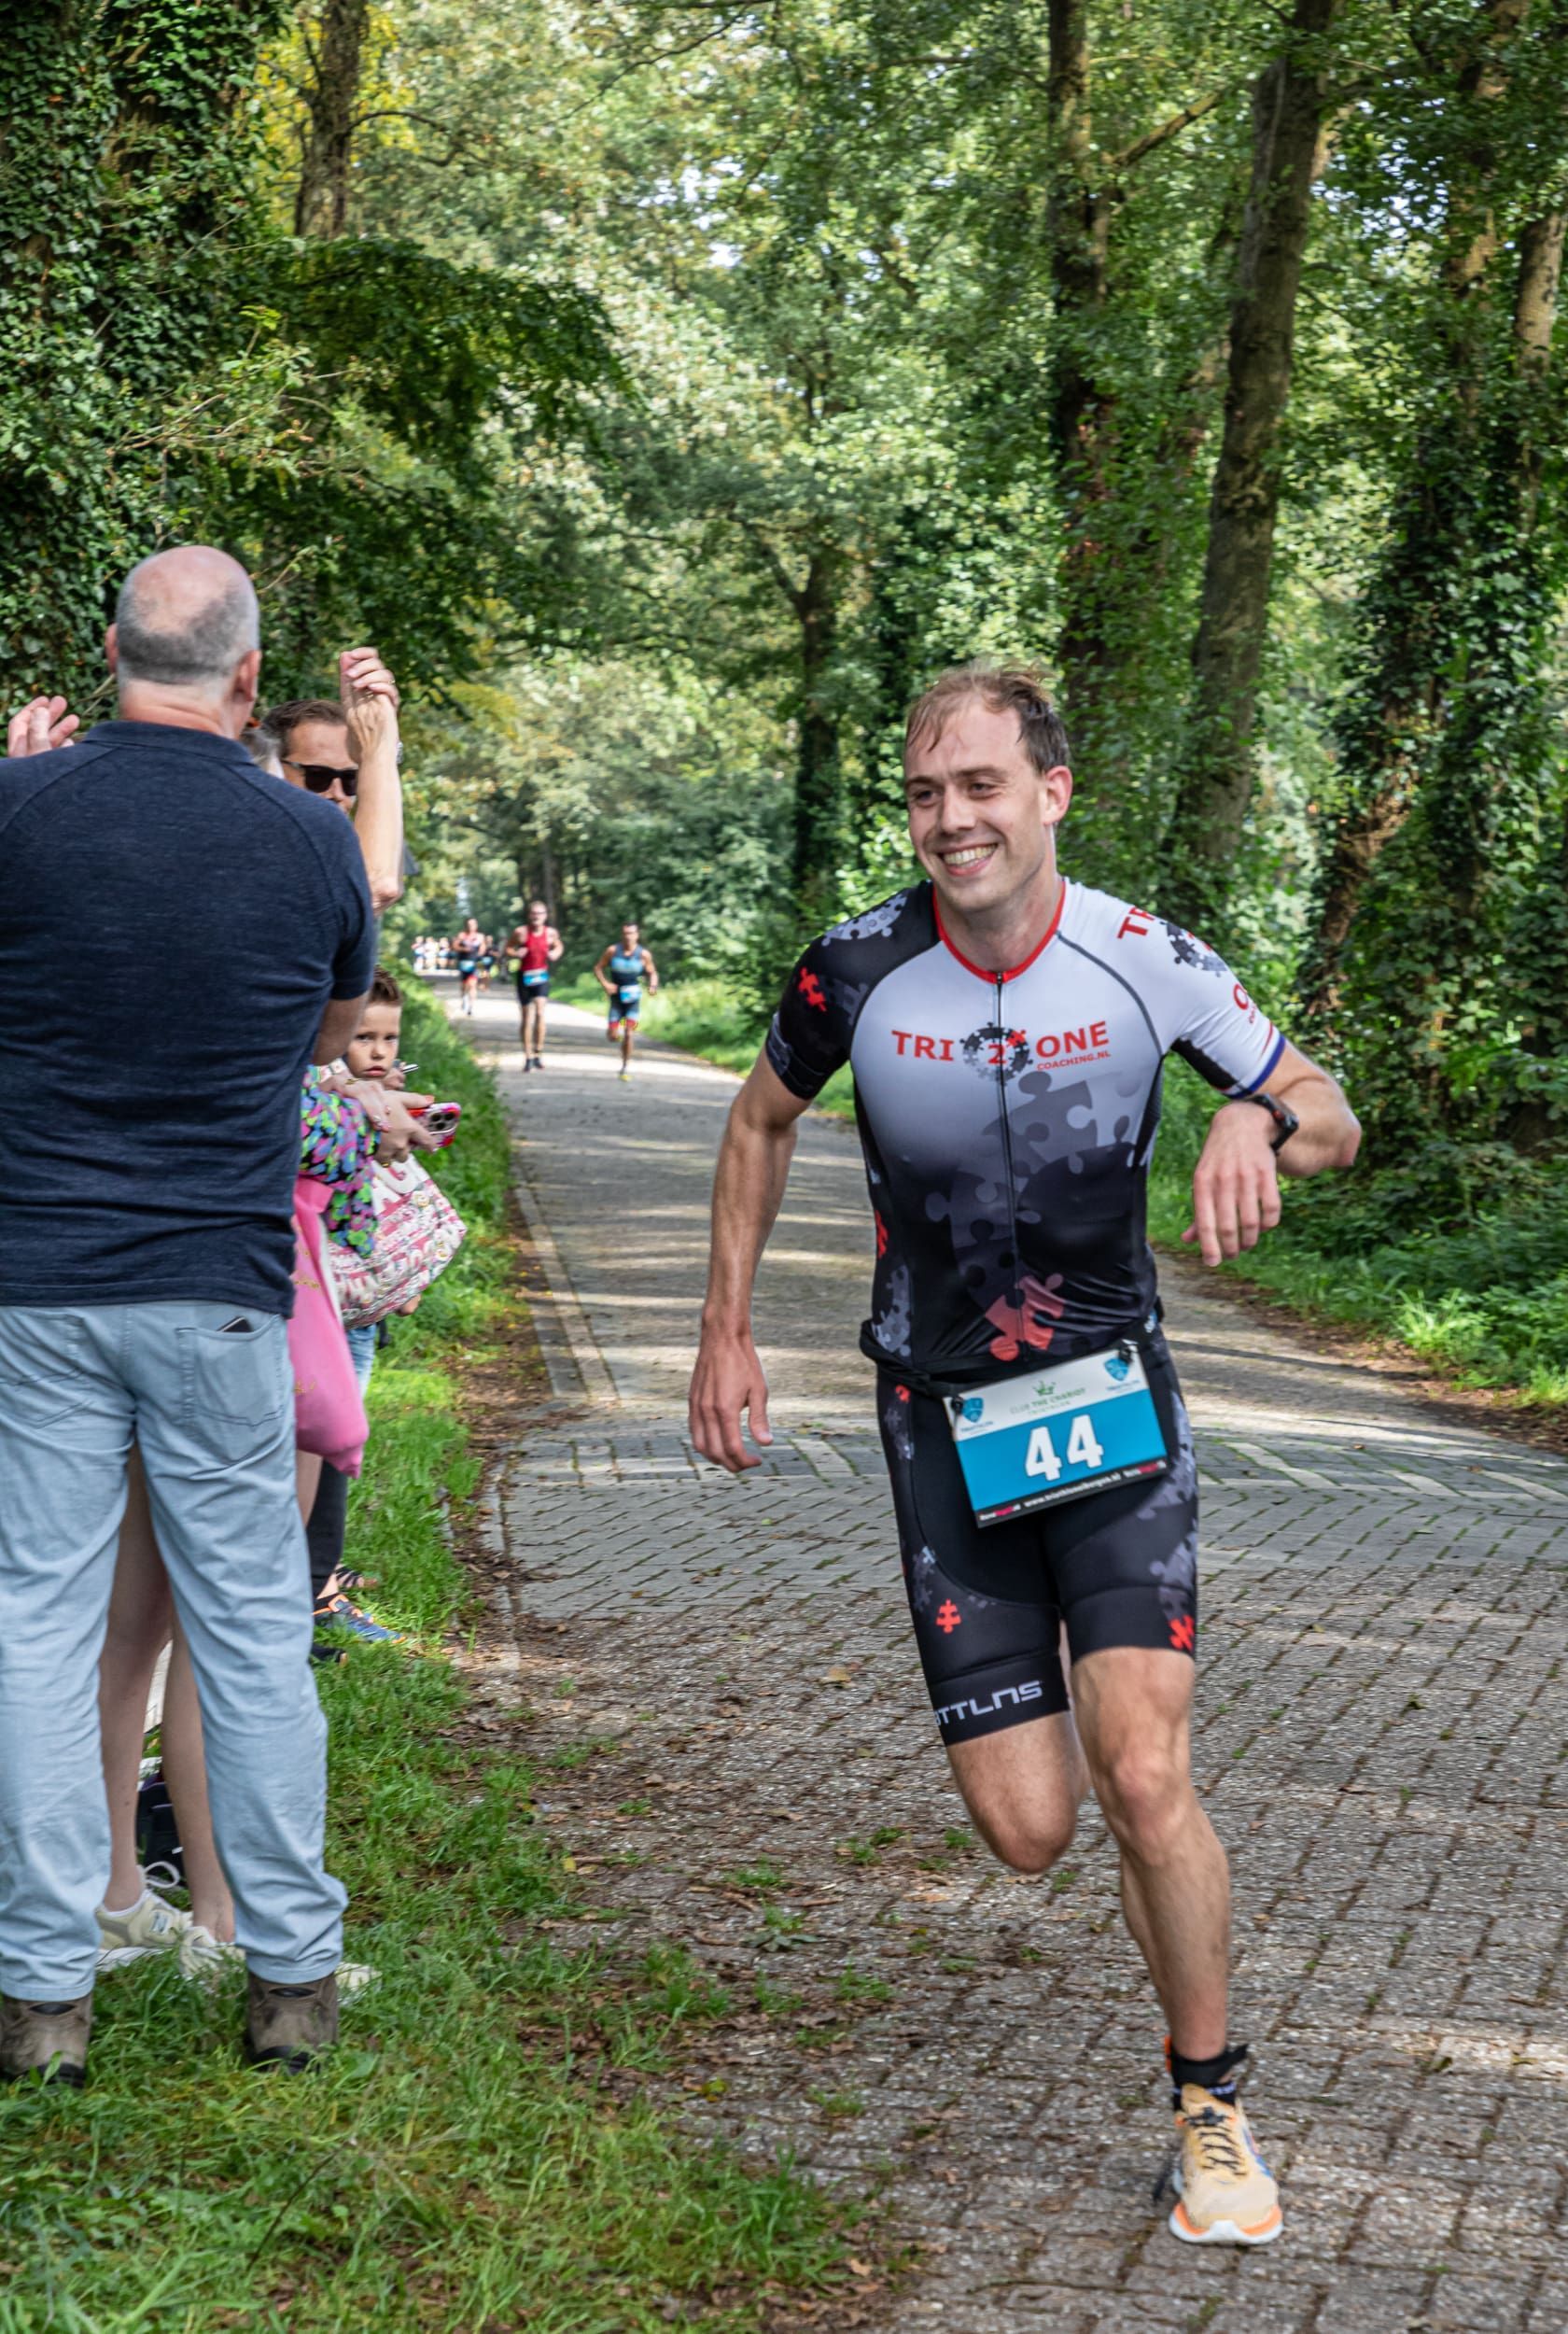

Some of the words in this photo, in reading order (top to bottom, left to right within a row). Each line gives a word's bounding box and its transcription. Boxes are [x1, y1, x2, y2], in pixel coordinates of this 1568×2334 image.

[891, 1030, 954, 1062] TRI
[987, 1044, 1007, 1064] 2
[1036, 1020, 1109, 1058] ONE
[1037, 1050, 1111, 1071] COACHING.NL
[1025, 1414, 1104, 1482] 44
